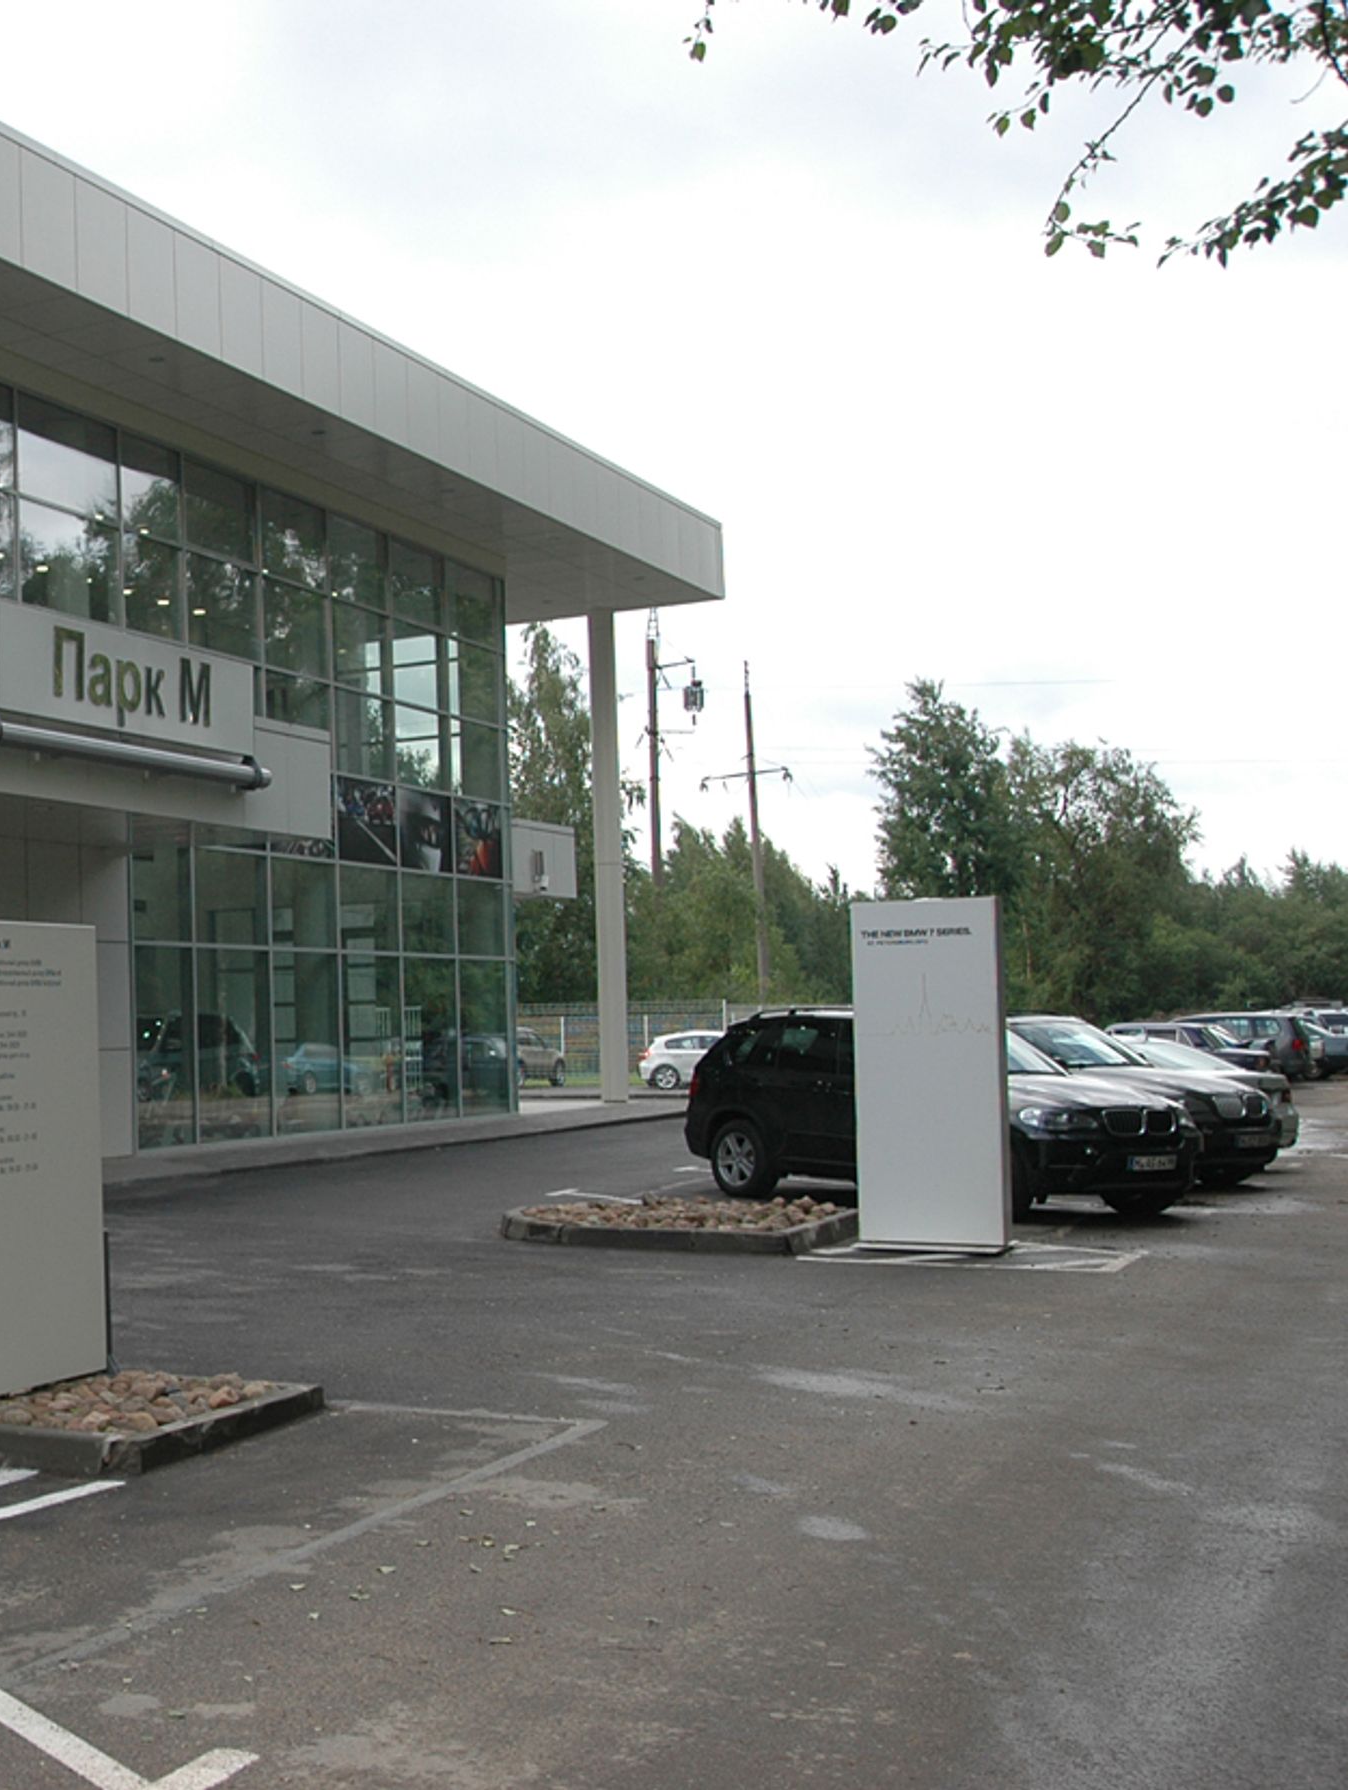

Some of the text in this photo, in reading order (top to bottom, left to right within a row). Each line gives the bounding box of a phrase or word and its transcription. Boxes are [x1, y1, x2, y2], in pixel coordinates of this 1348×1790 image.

[54, 625, 211, 728] Парк М
[904, 927, 927, 937] BMW
